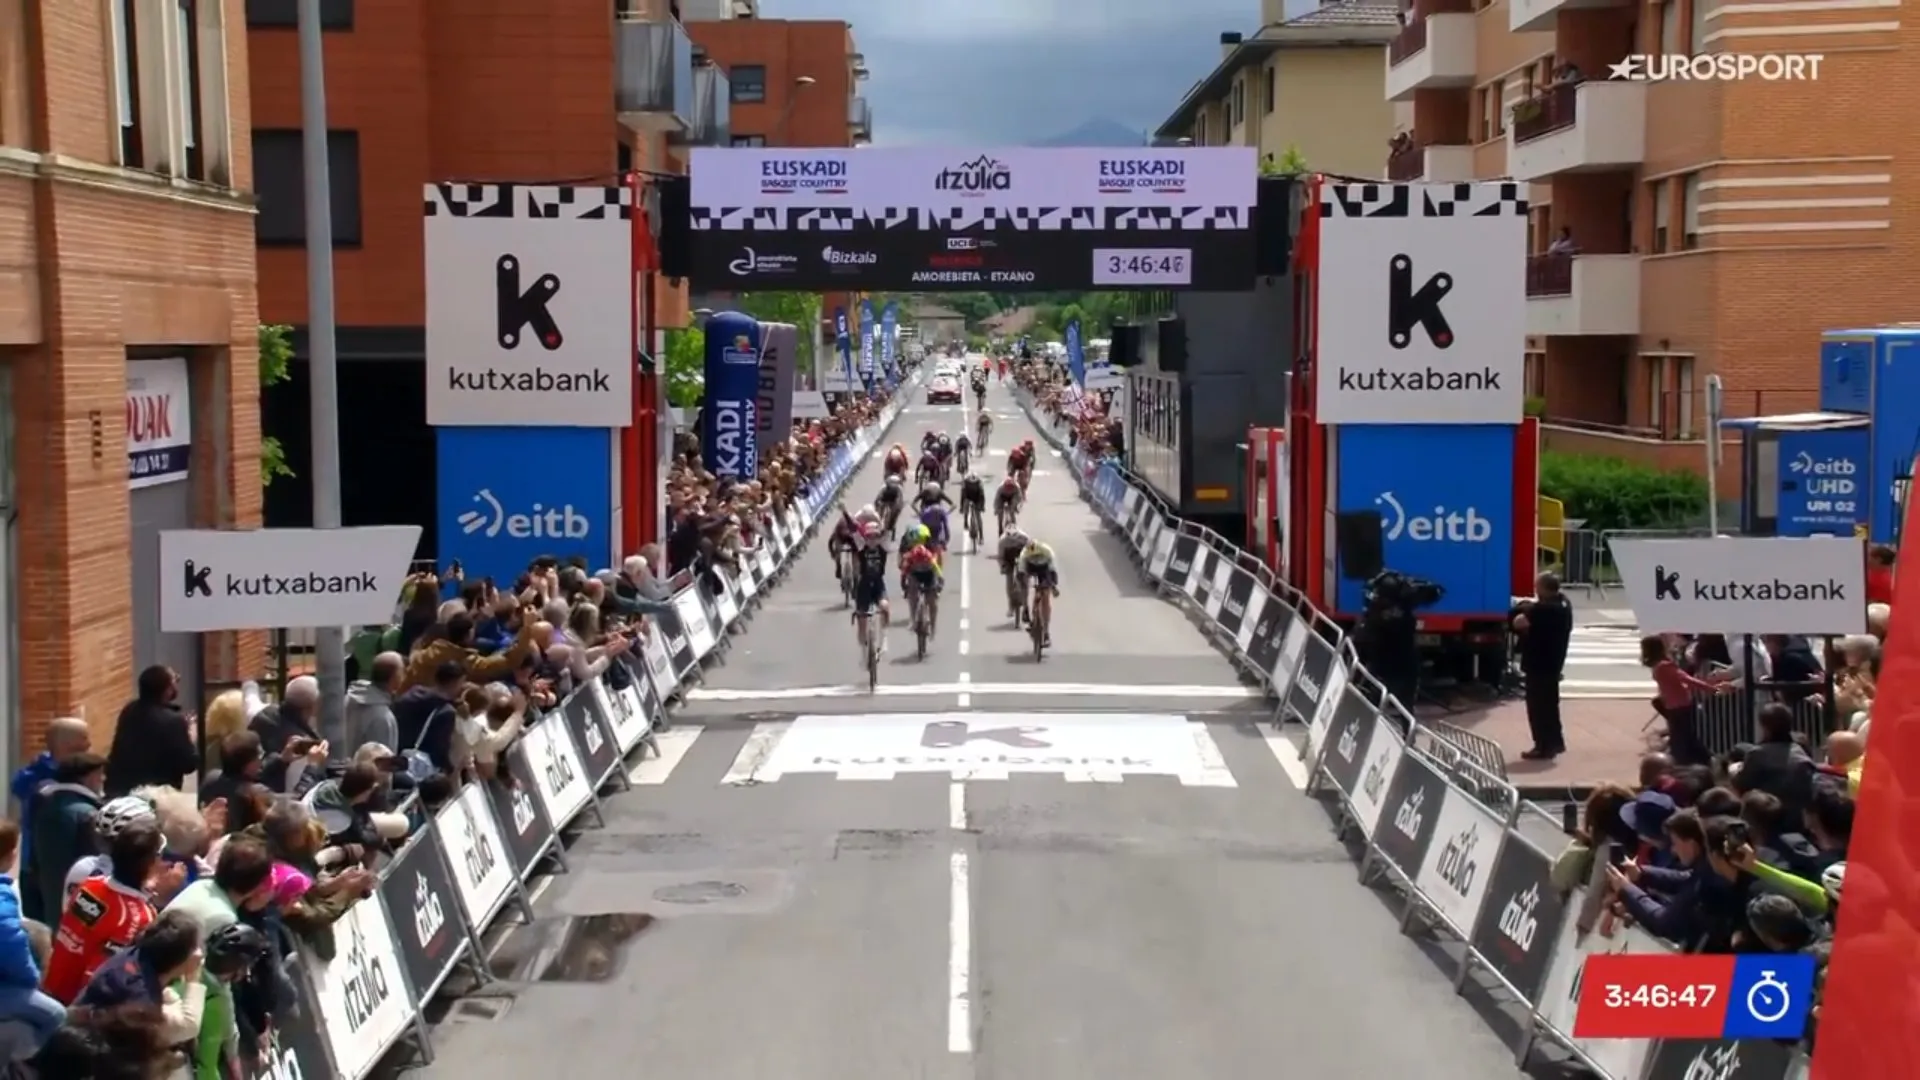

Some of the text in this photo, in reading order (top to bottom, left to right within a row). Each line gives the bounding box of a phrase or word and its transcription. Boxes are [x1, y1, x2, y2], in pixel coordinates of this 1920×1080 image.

[761, 160, 846, 176] EUSKADI
[1100, 160, 1185, 175] EUSKADI
[761, 179, 848, 188] BASQUE COUNTRY
[1099, 178, 1186, 187] BASQUE COUNTRY
[911, 271, 980, 282] AMOREBIETA
[990, 271, 1034, 282] ETXANO
[449, 366, 610, 392] kutxabank
[1339, 366, 1501, 391] kutxabank
[744, 399, 755, 476] COUNTRY
[1813, 458, 1856, 475] eitb
[1806, 479, 1854, 494] UHD
[507, 502, 589, 538] eitb
[1407, 505, 1491, 541] eitb
[226, 571, 378, 596] kutxabank
[1694, 579, 1845, 600] kutxabank
